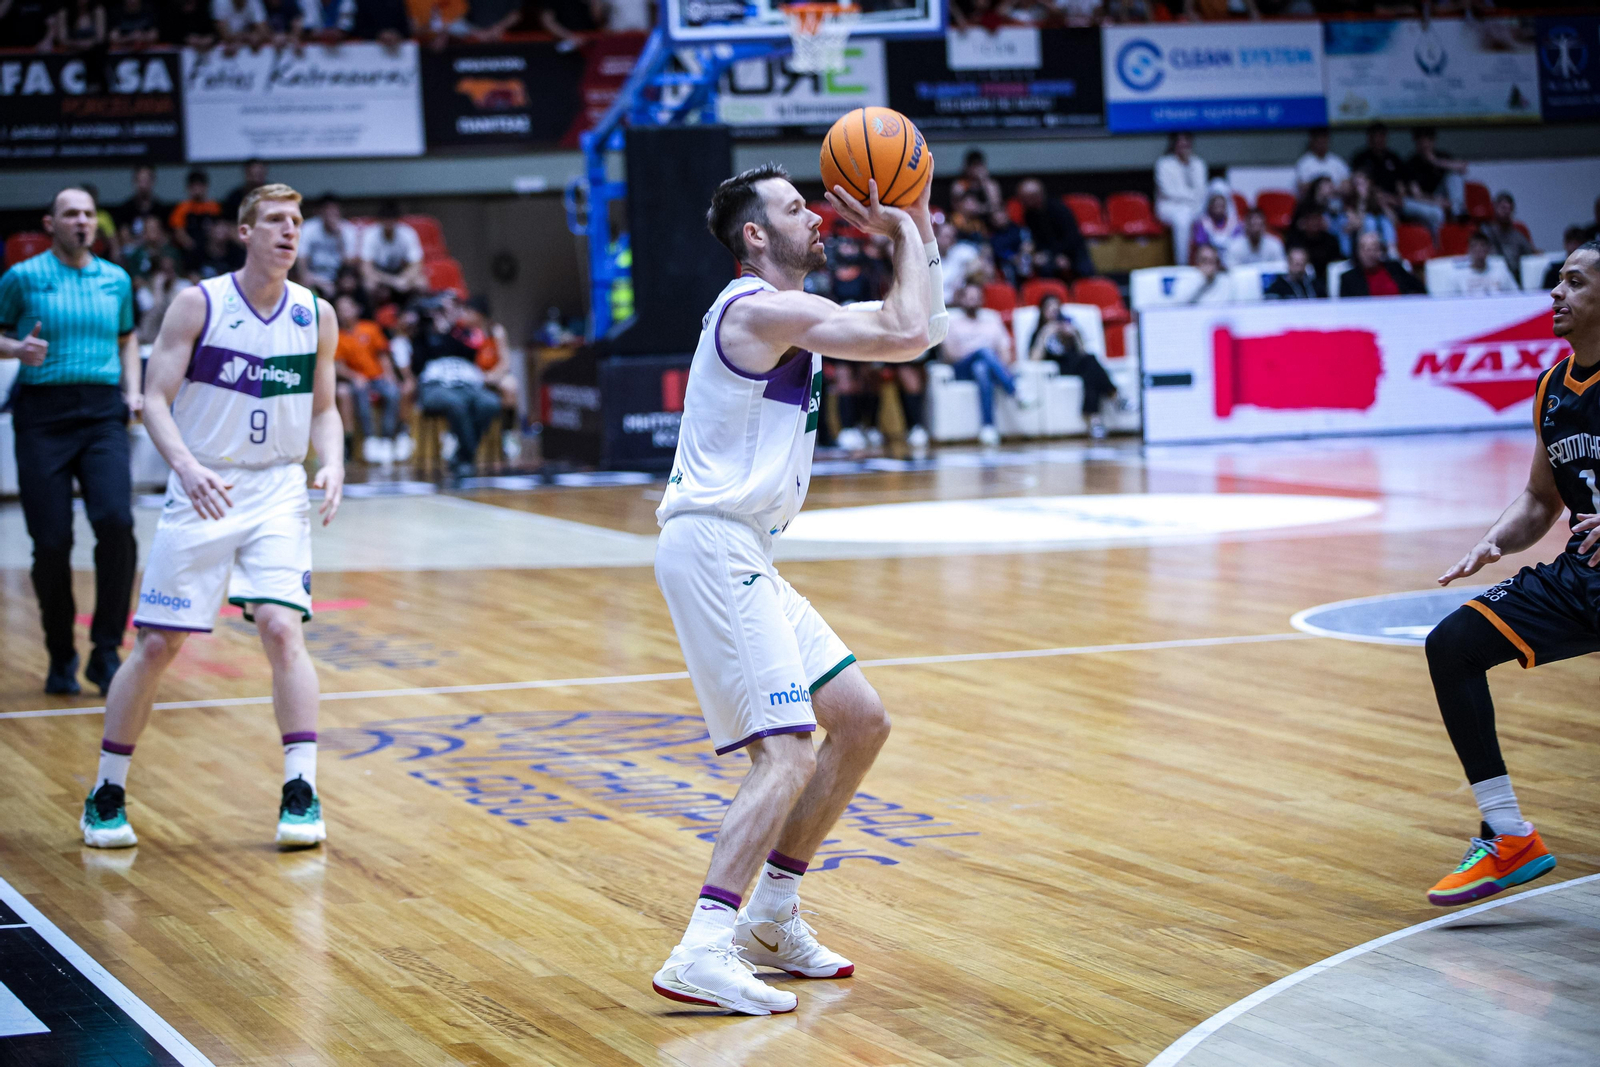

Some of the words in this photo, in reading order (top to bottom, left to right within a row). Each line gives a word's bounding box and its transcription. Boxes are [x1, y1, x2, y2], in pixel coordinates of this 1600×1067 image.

[60, 58, 174, 96] CSA
[246, 364, 301, 389] Unicaja
[250, 409, 268, 444] 9
